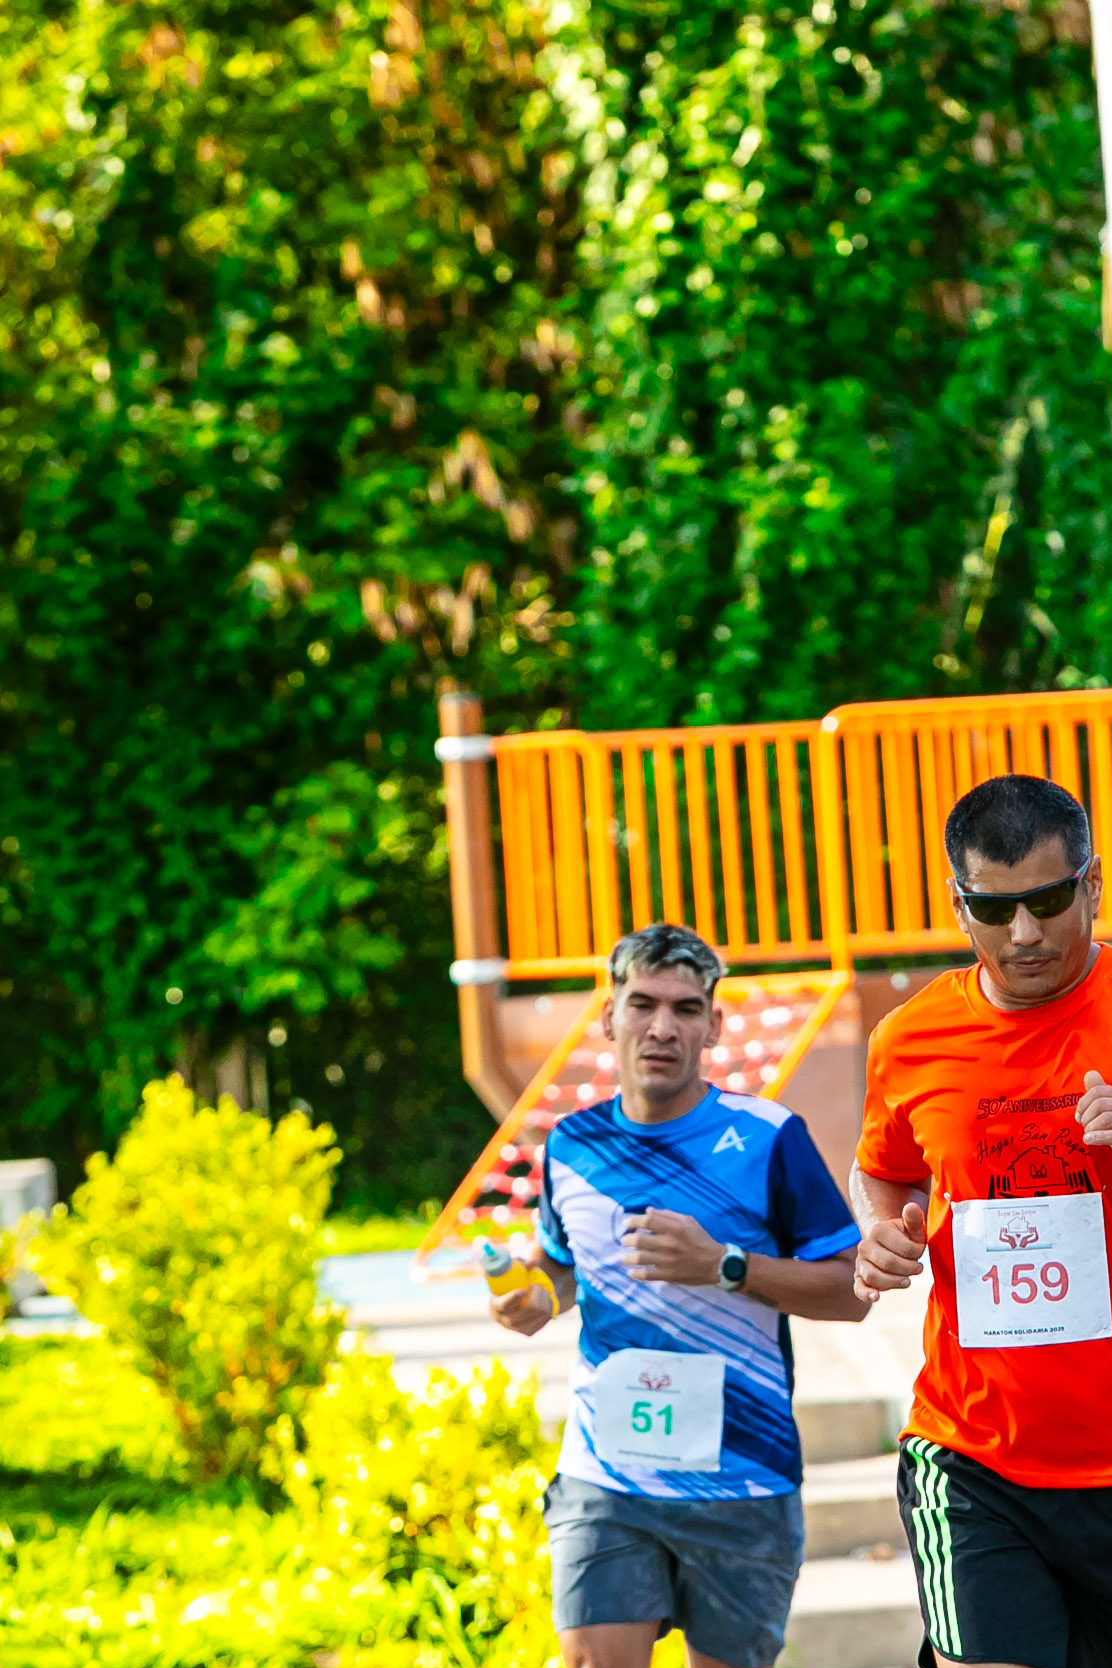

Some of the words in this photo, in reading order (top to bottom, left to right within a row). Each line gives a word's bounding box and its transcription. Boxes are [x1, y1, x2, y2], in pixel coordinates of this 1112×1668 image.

[1018, 1122, 1048, 1142] San
[982, 1261, 1069, 1305] 159
[1014, 1327, 1048, 1335] SOLIDARIA
[632, 1401, 673, 1436] 51
